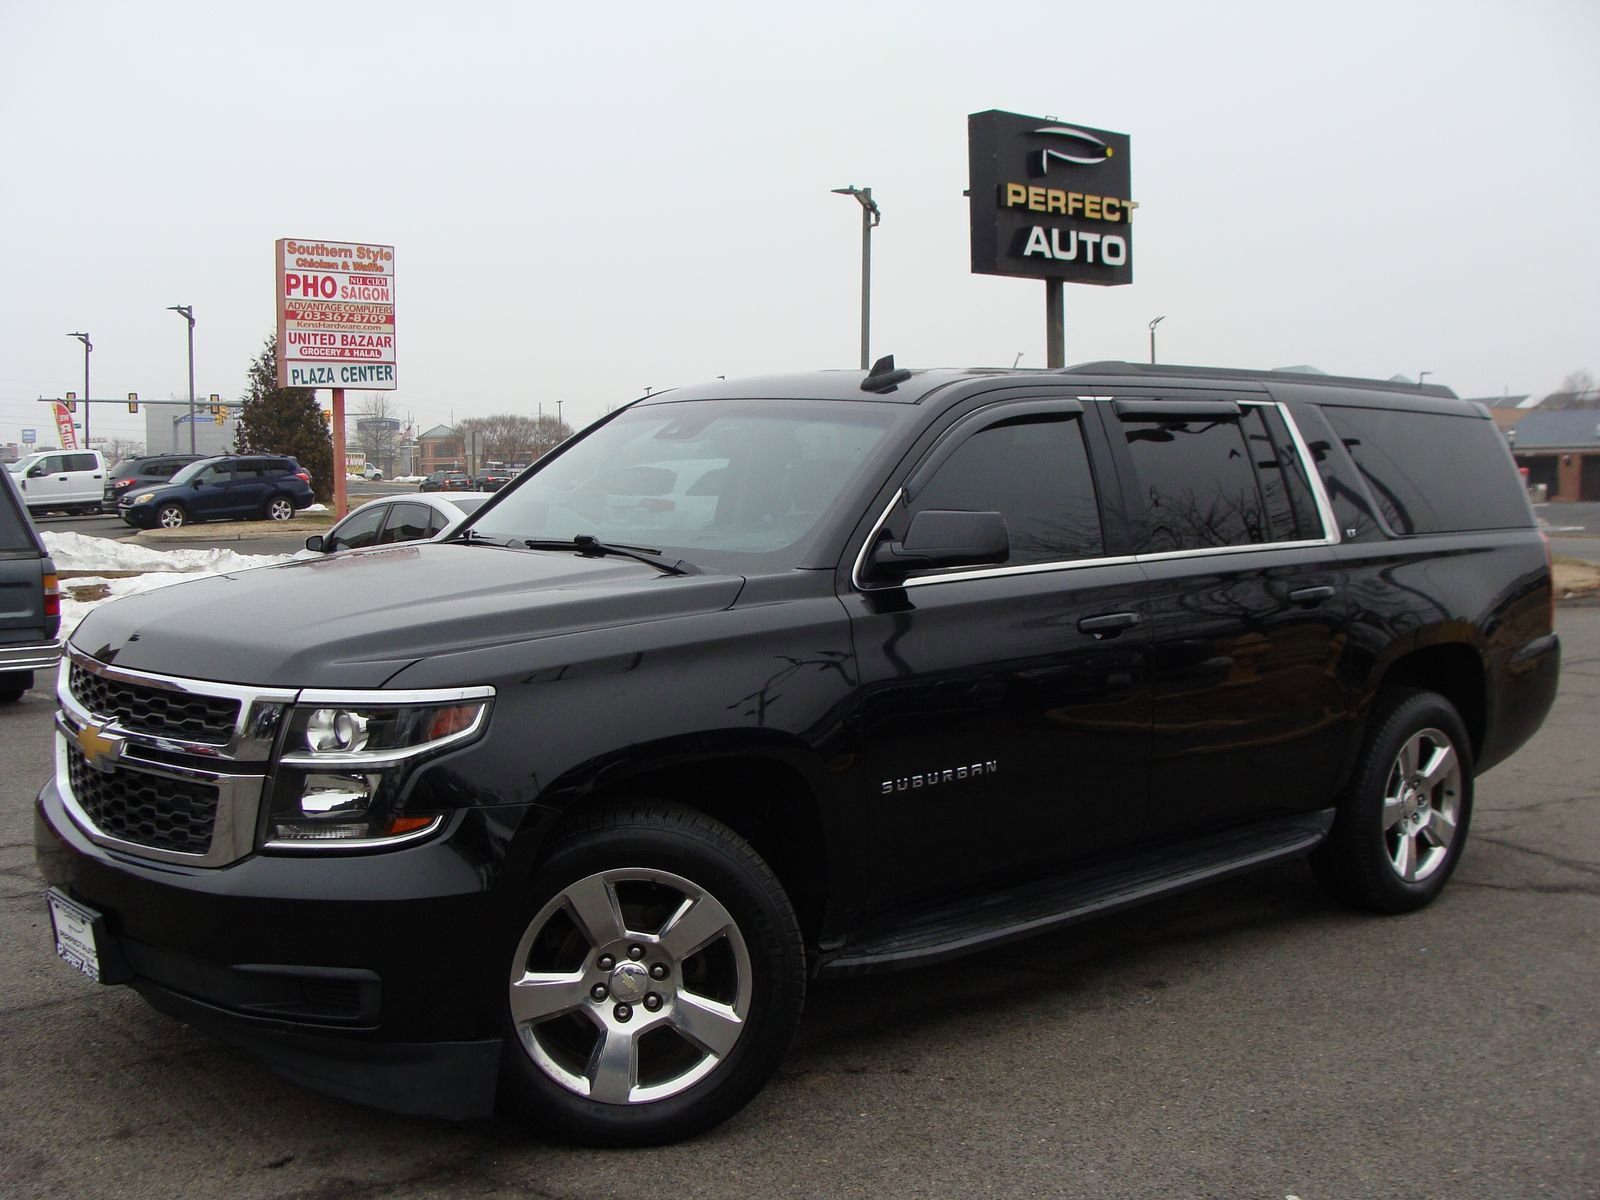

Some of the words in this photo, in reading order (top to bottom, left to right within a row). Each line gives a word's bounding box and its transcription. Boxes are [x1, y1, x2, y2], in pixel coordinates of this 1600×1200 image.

[1007, 182, 1139, 224] PERFECT
[287, 241, 353, 258] Southern
[356, 246, 392, 263] Style
[1023, 225, 1126, 266] AUTO
[295, 257, 339, 270] Chicken
[341, 261, 350, 271] &
[352, 261, 384, 273] Waffle
[285, 274, 337, 299] PHO
[341, 286, 389, 301] SAIGON
[287, 301, 342, 312] ADVANTAGE
[343, 304, 393, 315] COMPUTERS
[296, 311, 387, 323] 703-367-8709
[296, 321, 382, 332] KensHardware.com
[288, 332, 336, 346] UNITED
[341, 334, 393, 349] BAZAAR
[301, 347, 342, 357] GROCERY
[353, 350, 380, 358] HALAL
[291, 367, 336, 386] PLAZA
[340, 365, 394, 383] CENTER
[881, 760, 997, 794] SUBURBAN
